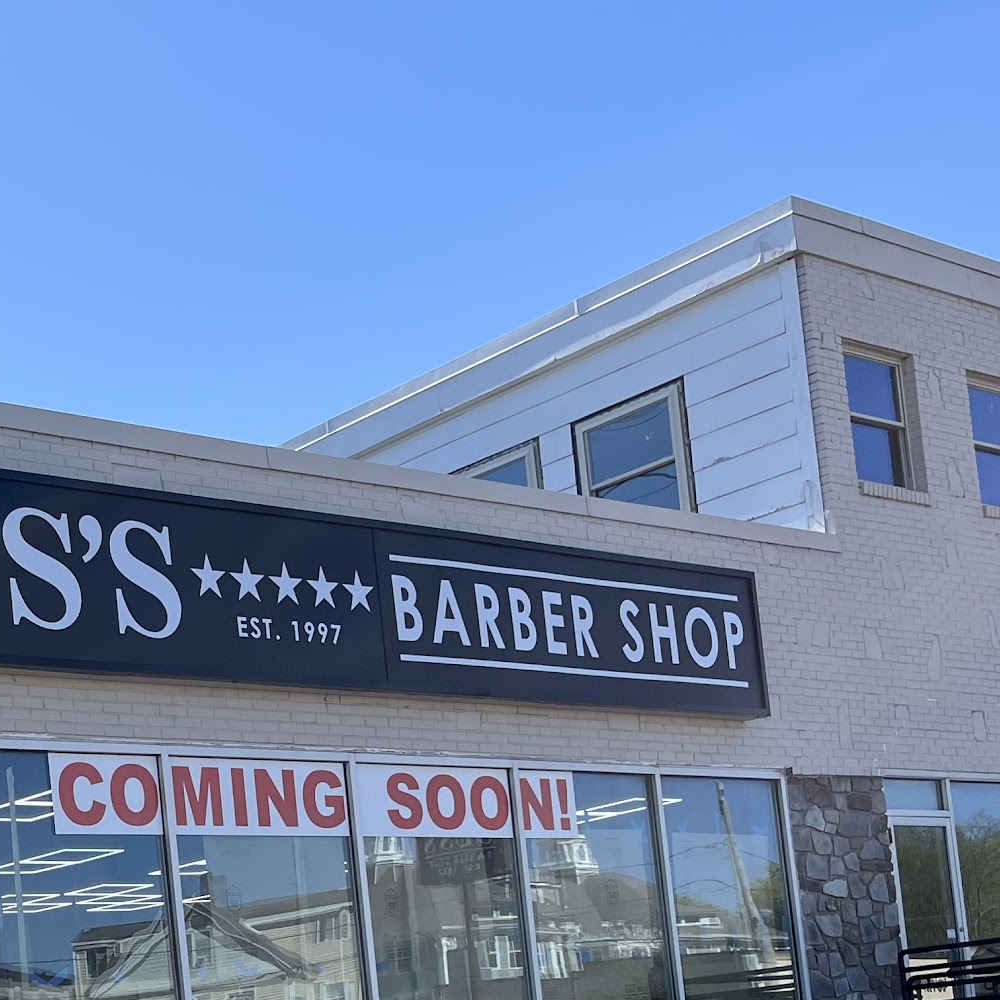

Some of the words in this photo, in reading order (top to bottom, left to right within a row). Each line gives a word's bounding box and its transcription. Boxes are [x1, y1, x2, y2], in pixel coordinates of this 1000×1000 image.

[237, 616, 281, 641] EST.
[291, 620, 342, 645] 1997
[391, 574, 599, 659] BARBER
[619, 599, 744, 670] SHOP
[58, 761, 346, 829] COMING
[387, 772, 571, 832] SOON!
